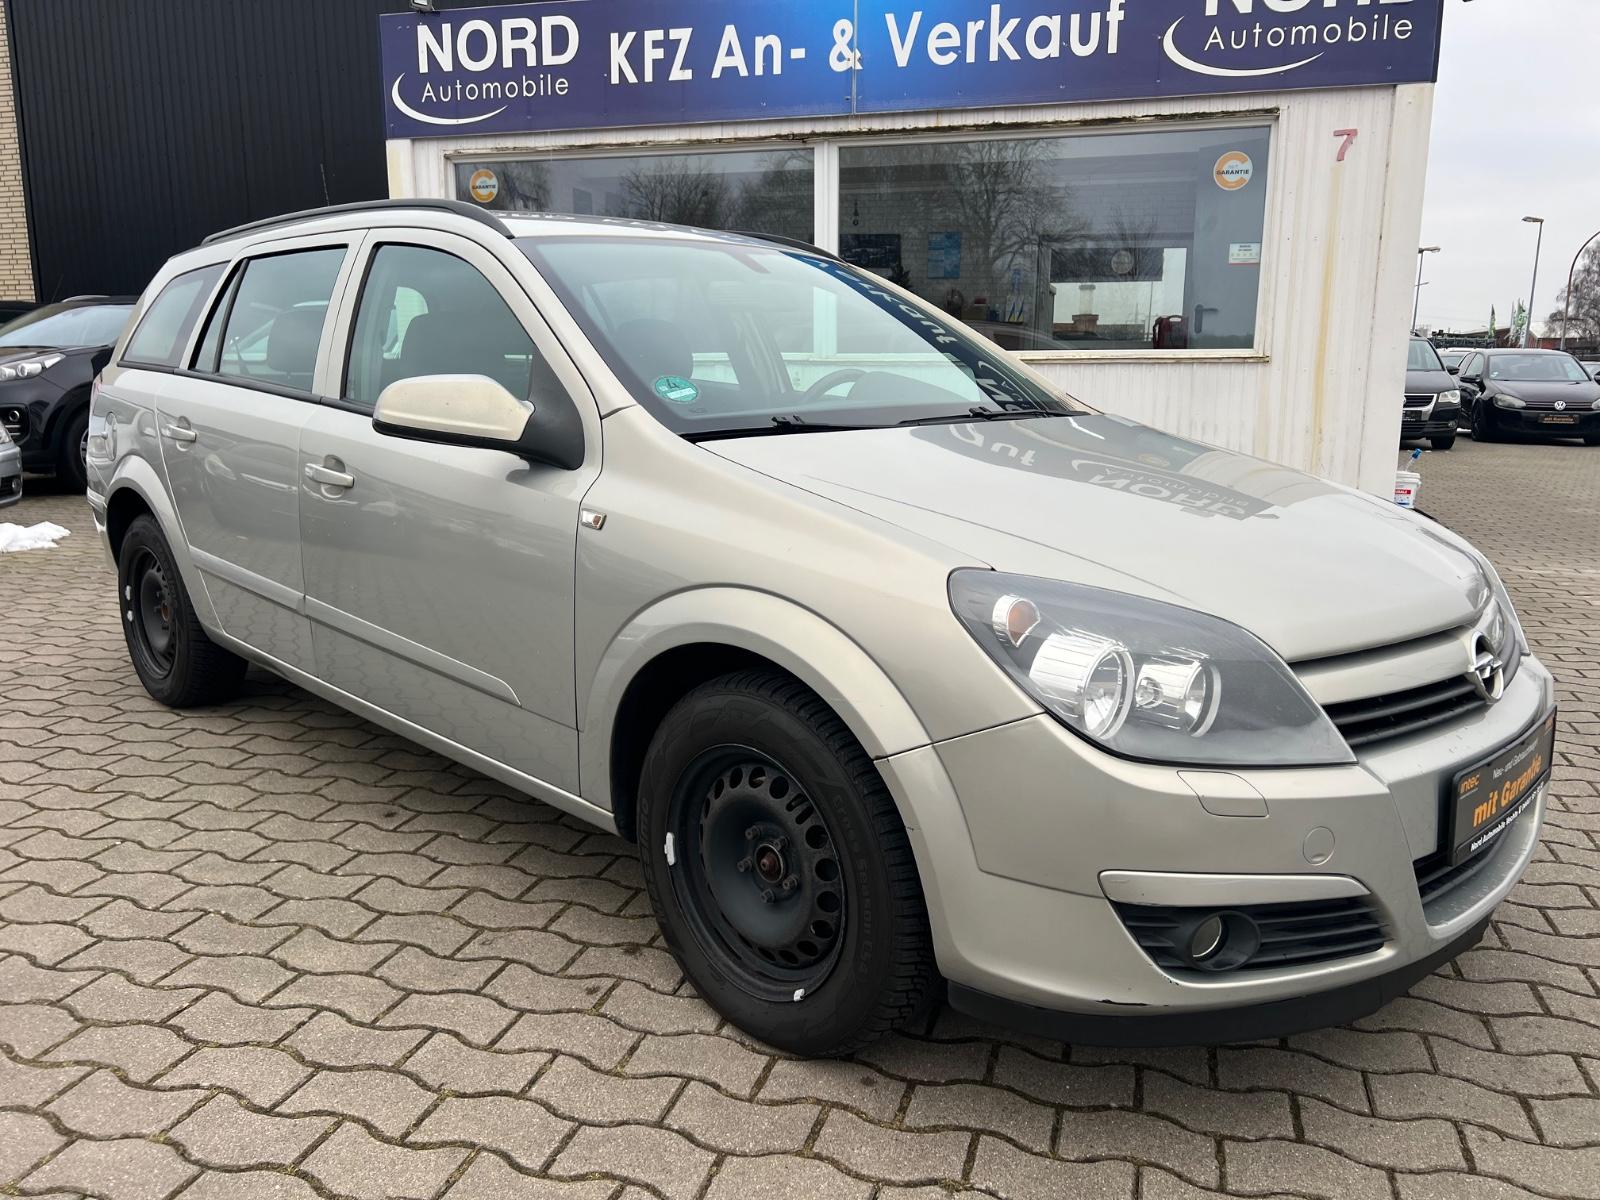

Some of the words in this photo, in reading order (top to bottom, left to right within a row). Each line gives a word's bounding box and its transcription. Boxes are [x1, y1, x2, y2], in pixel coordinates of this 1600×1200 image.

[417, 15, 579, 74] NORD
[610, 27, 694, 85] KFZ
[711, 24, 806, 79] An-
[829, 18, 863, 73] &
[885, 0, 1126, 68] Verkauf
[1203, 14, 1413, 51] Automobile
[421, 74, 570, 103] Automobile
[1333, 128, 1359, 163] 7
[1473, 790, 1498, 828] mit
[1501, 753, 1543, 807] Garantie
